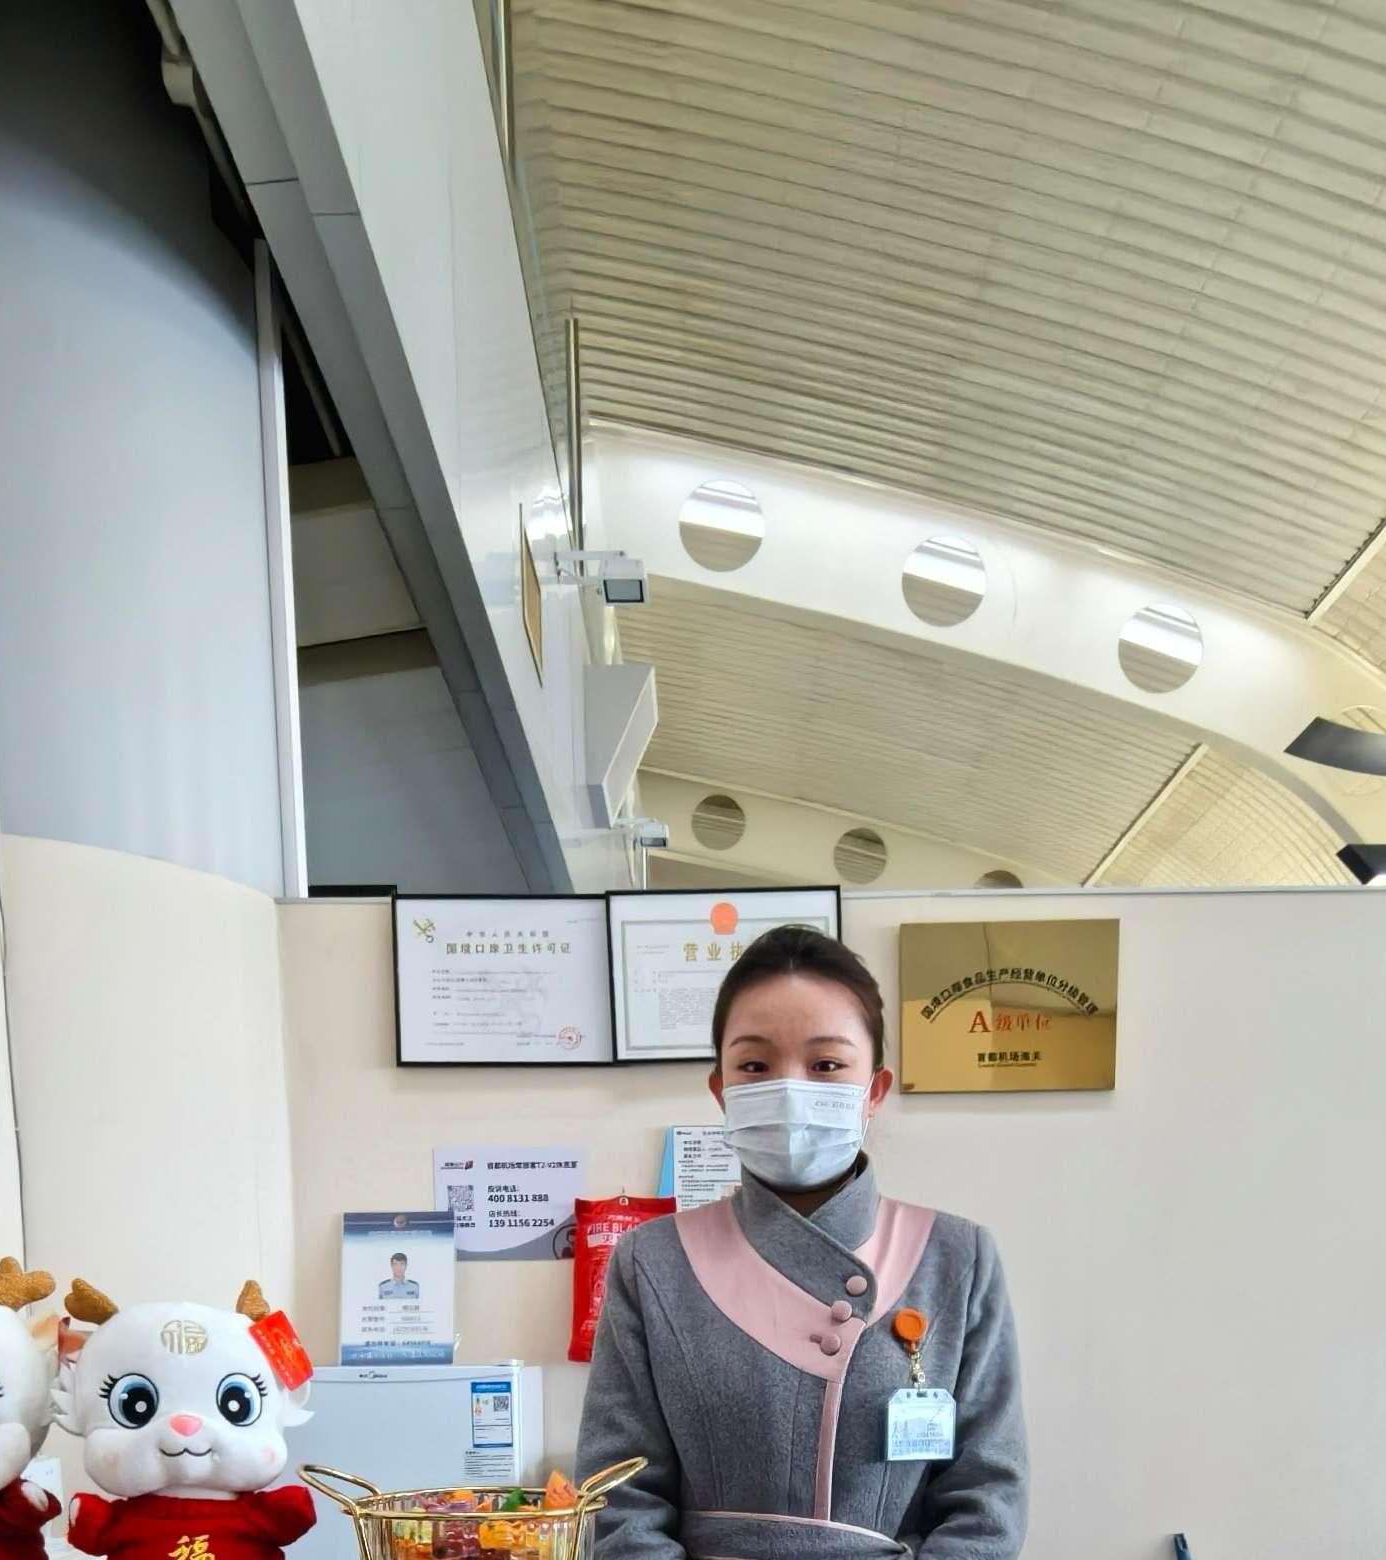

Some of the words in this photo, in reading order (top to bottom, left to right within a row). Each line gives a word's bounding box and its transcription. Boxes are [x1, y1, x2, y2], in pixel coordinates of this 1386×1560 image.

[488, 1194, 505, 1203] 400
[507, 1194, 530, 1203] 8131
[488, 1219, 506, 1228] 139
[508, 1219, 530, 1227] 1156
[532, 1218, 555, 1227] 2254
